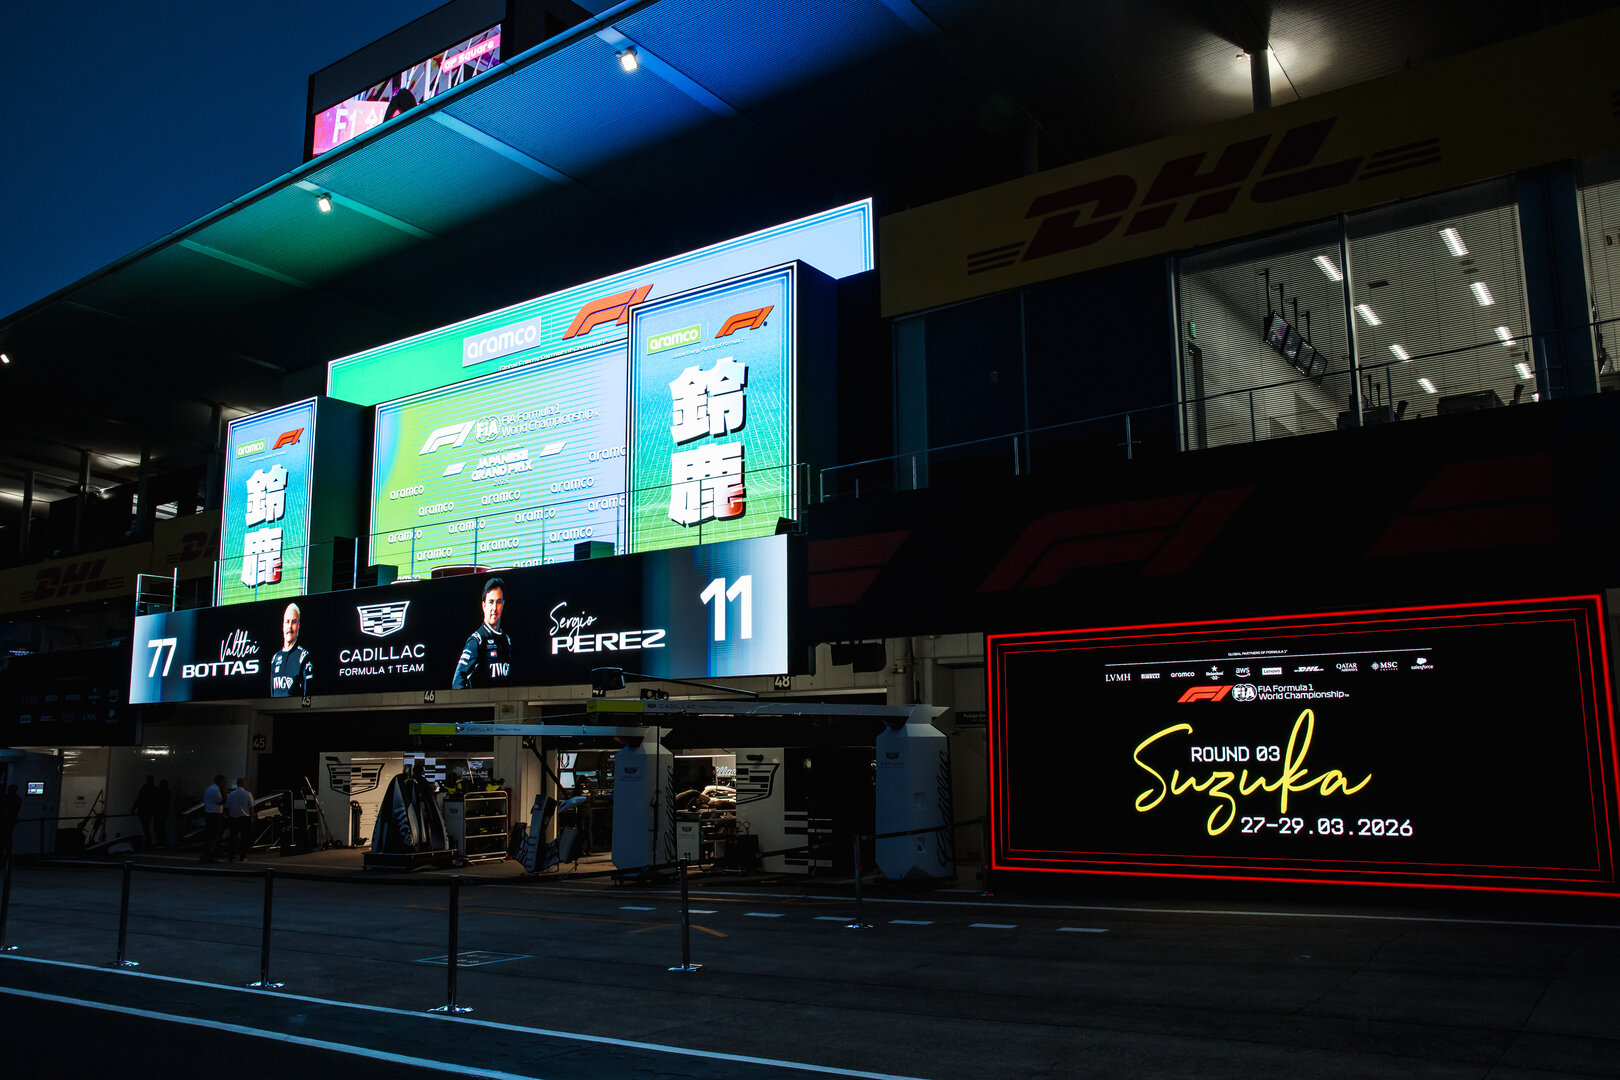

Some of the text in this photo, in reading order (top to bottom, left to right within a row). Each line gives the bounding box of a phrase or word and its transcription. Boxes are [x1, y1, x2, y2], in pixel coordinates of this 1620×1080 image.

[1021, 116, 1364, 262] DHL
[467, 325, 538, 359] aramco
[650, 328, 699, 350] aramco
[501, 413, 516, 425] FIA
[517, 404, 554, 420] Formula
[501, 420, 527, 437] World
[237, 441, 265, 456] aramco
[667, 355, 749, 528] 鈴鹿
[476, 449, 528, 471] JAPANESE
[588, 445, 626, 462] aramc
[472, 460, 533, 482] GRAND PRIX
[389, 484, 425, 500] aramco
[550, 476, 594, 494] aramco
[481, 489, 521, 506] aramco
[587, 495, 625, 512] aramc
[418, 501, 455, 517] aramco
[514, 507, 556, 523] aramco
[549, 526, 593, 543] aramco
[480, 536, 520, 553] aramco
[416, 547, 453, 562] aramco
[33, 558, 109, 600] DHL
[700, 574, 753, 642] 11
[549, 601, 598, 648] Sergio
[219, 628, 261, 663] Valtteri
[551, 628, 666, 655] PEREZ
[148, 637, 178, 678] 77
[339, 643, 426, 664] CADILLAC
[182, 659, 260, 679] BOTTAS
[339, 665, 386, 677] FORMULA
[395, 663, 425, 673] TEAM
[1105, 673, 1131, 682] LVMH
[774, 676, 790, 688] 48
[1258, 685, 1271, 693] FIA
[1272, 684, 1308, 692] Formula
[302, 696, 311, 706] 45
[424, 690, 435, 702] 46
[1258, 691, 1283, 700] World
[253, 736, 266, 749] 45
[1191, 746, 1280, 762] ROUND 03
[1133, 708, 1372, 836] Suzuka
